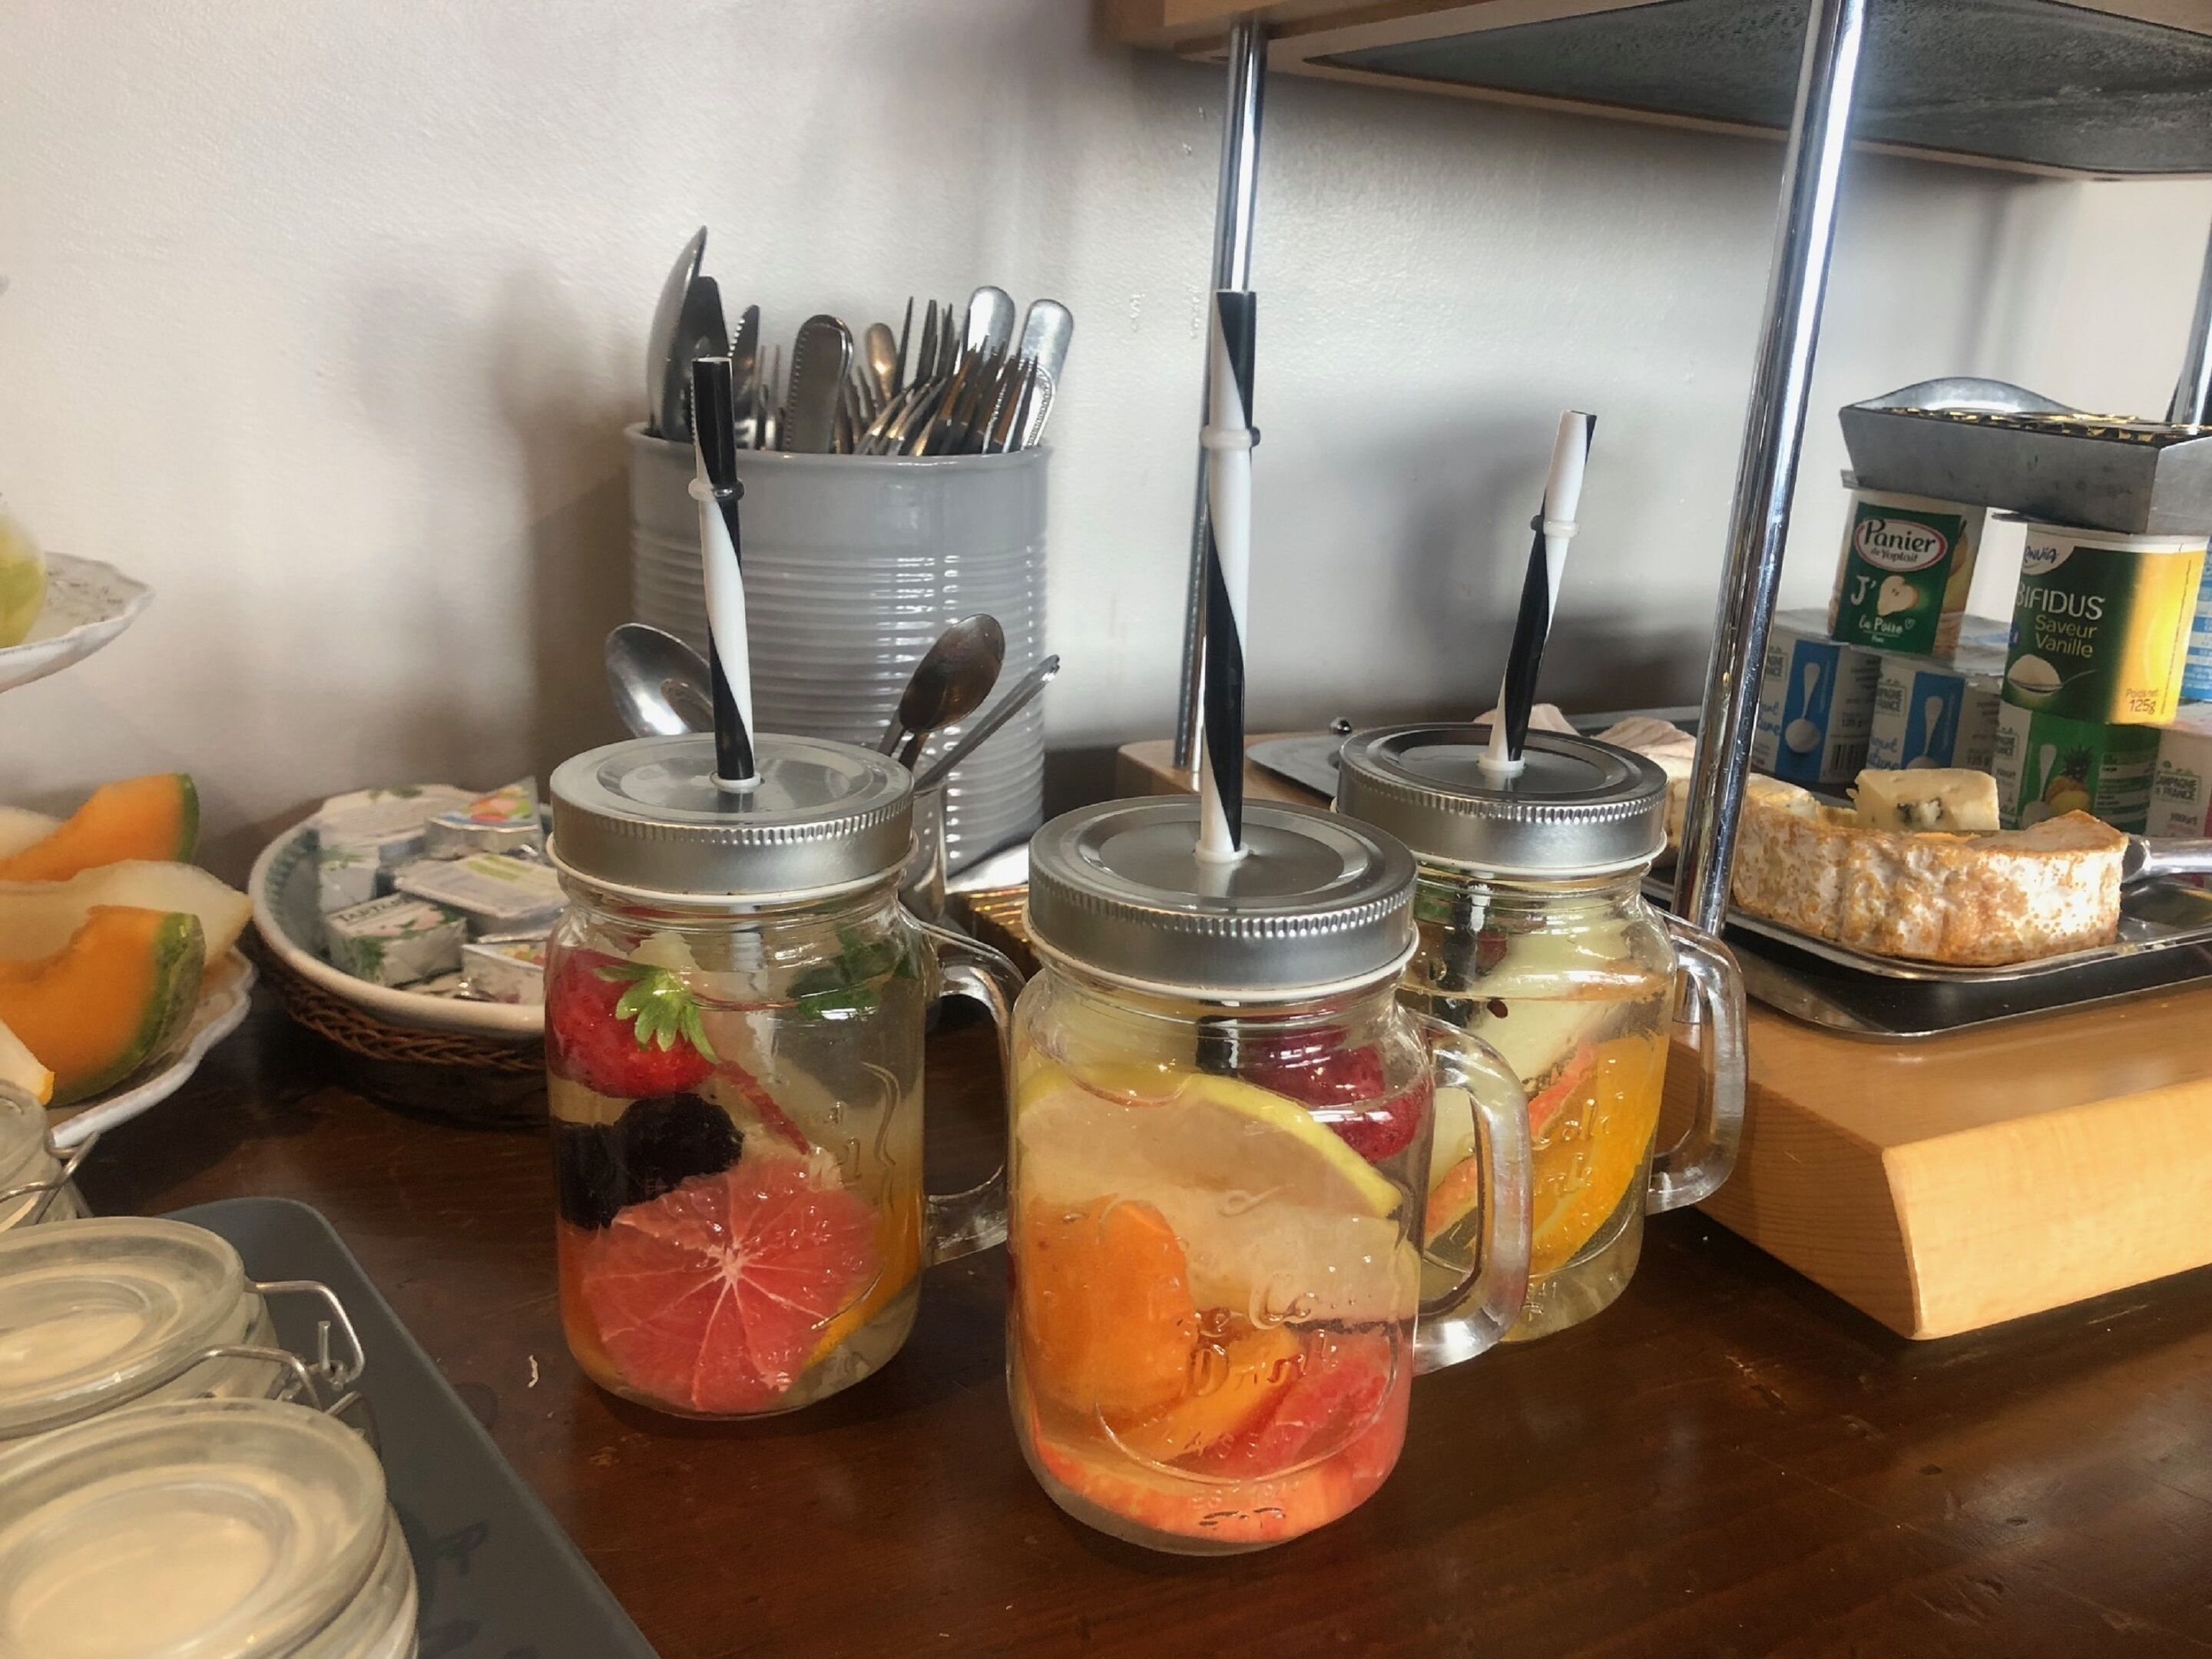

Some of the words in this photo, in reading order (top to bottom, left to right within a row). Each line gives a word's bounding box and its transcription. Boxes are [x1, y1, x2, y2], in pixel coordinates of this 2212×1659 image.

[1864, 518, 1936, 553] Panier
[1881, 548, 1919, 564] Yoplait
[2015, 582, 2106, 621] BIFIDUS
[2035, 614, 2098, 639] Saveur
[2035, 632, 2094, 658] Vanille
[2128, 697, 2157, 715] 125g
